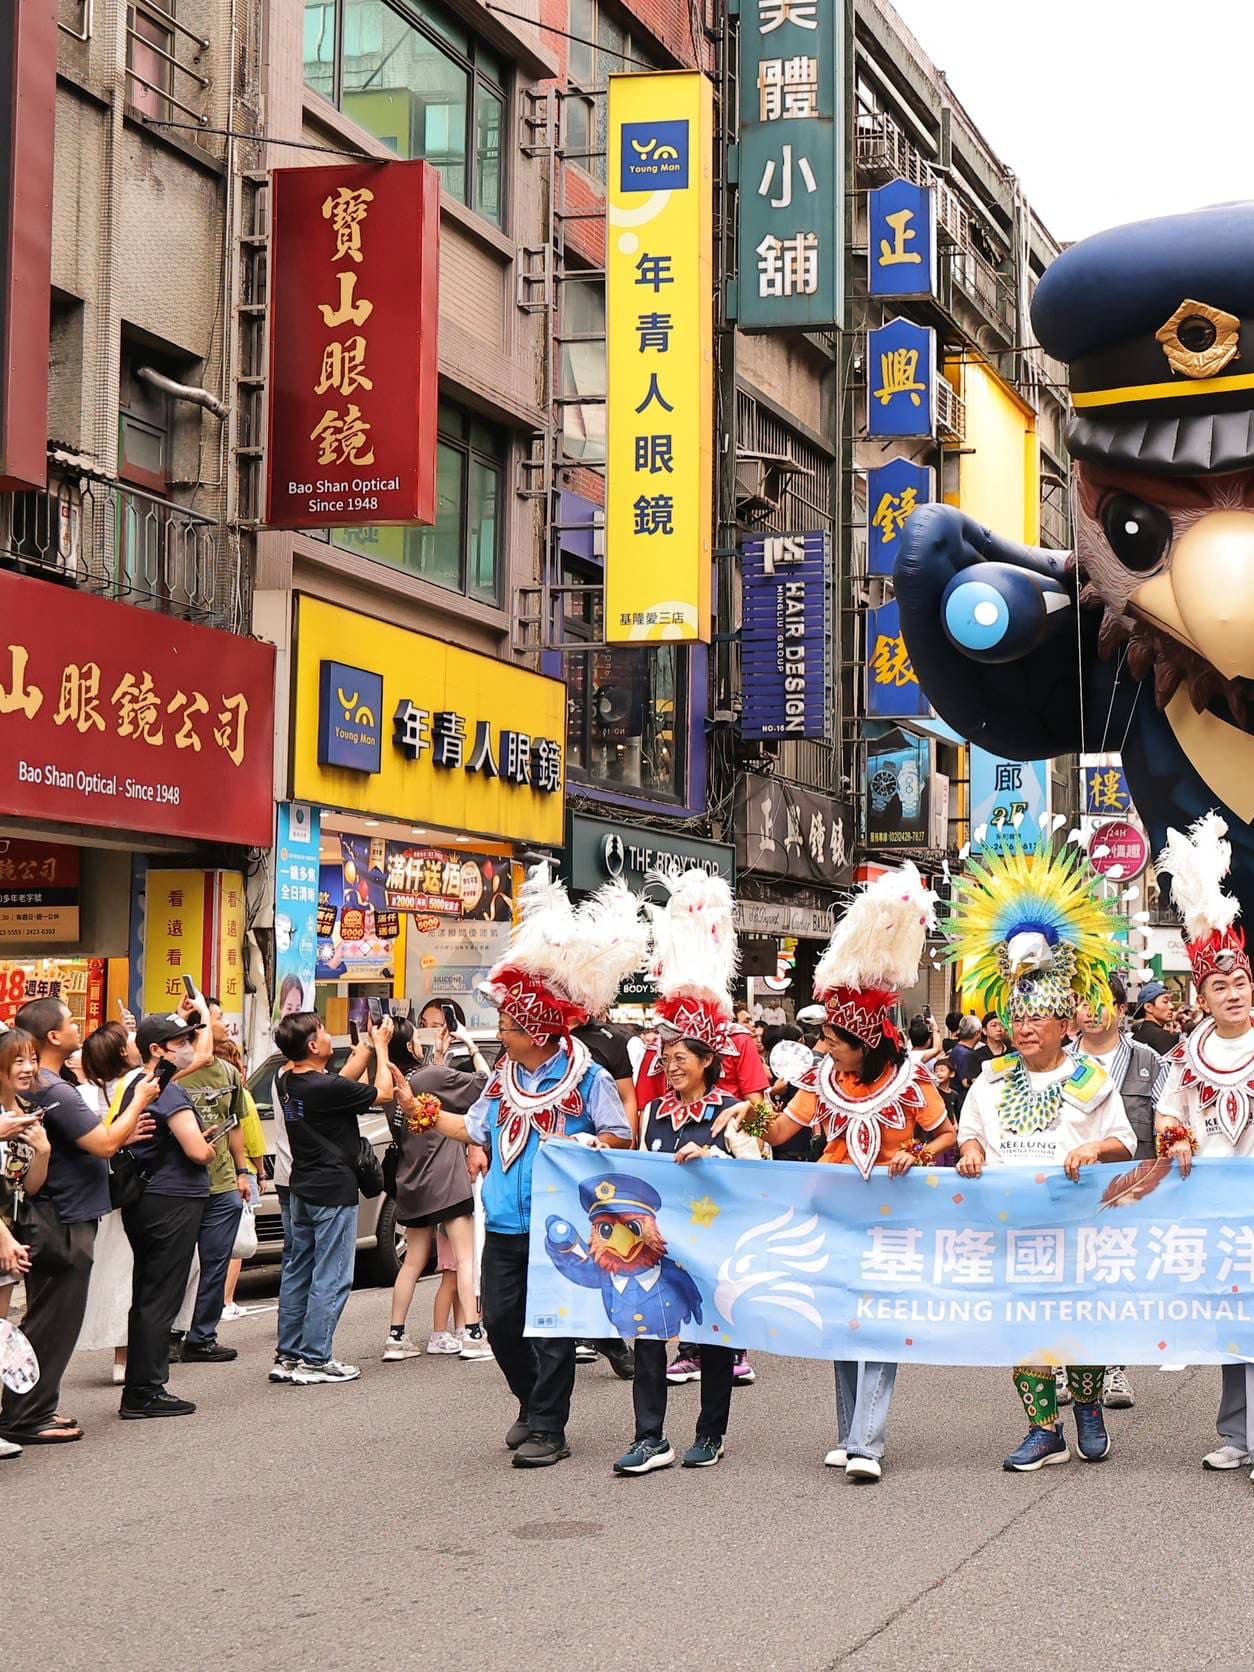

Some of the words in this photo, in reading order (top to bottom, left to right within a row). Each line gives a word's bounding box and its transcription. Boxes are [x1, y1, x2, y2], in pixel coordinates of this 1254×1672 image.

[629, 164, 658, 174] Young
[660, 163, 681, 172] Man
[309, 187, 376, 467] 寶山眼鏡
[633, 253, 675, 536] 年青人眼鏡
[288, 480, 313, 494] Bao
[316, 479, 349, 493] Shan
[352, 476, 400, 494] Optical
[308, 499, 344, 512] Since
[347, 497, 378, 511] 1948
[619, 611, 685, 626] 基隆愛三店
[776, 585, 784, 628] MINGLIU
[784, 581, 805, 639] HAIR
[776, 635, 784, 672] GROUP
[0, 644, 250, 767] 山眼鏡公司
[784, 645, 806, 732] DESIGN
[335, 725, 357, 745] Young
[358, 731, 376, 747] Man
[396, 699, 562, 793] 年青人眼鏡
[18, 761, 43, 784] Bao
[44, 765, 74, 790] Shan
[76, 770, 117, 796] Optical
[125, 777, 154, 801] Since
[155, 782, 181, 806] 1948
[994, 763, 1023, 792] 廊
[1089, 769, 1128, 810] 樓
[629, 846, 653, 872] THE
[656, 851, 688, 875] BODY
[165, 889, 184, 996] 看遠看近
[226, 890, 238, 996] 看遠看近
[623, 984, 648, 994] BODY
[856, 1297, 993, 1323] KEELUNG
[1005, 1298, 1251, 1323] INTERNATIONAL
